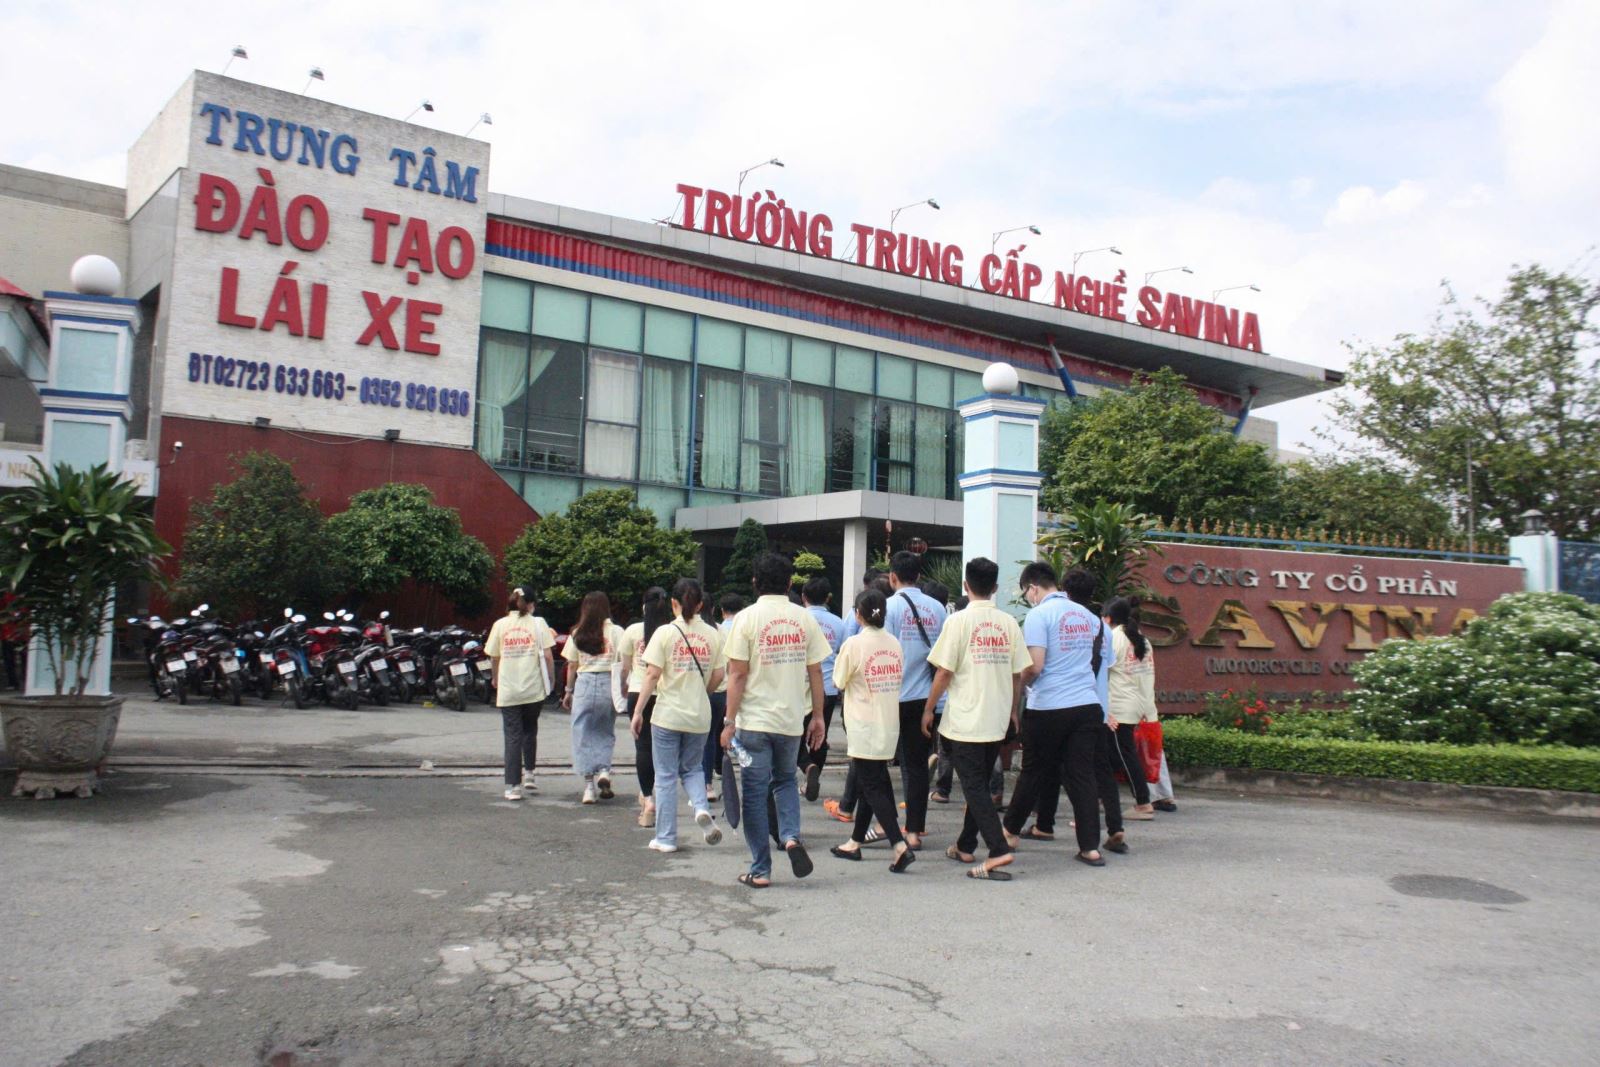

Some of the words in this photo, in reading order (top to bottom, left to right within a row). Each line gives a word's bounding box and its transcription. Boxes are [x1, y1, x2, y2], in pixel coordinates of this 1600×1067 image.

[201, 102, 360, 176] TRUNG
[389, 146, 480, 204] TÂM
[194, 167, 330, 251] ĐÀO
[363, 207, 475, 285] TẠO
[677, 183, 834, 260] TRƯỜNG
[851, 223, 964, 288] TRUNG
[980, 244, 1042, 302] CẤP
[1055, 269, 1128, 323] NGHỀ
[1136, 286, 1264, 354] SAVINA
[218, 260, 328, 340] LÁI
[355, 290, 443, 356] XE
[1163, 562, 1260, 588] CÔNG
[1270, 570, 1315, 590] TY
[1325, 564, 1368, 593] CỔ
[1376, 569, 1458, 597] PHẦN
[906, 616, 934, 626] SAINA
[1138, 594, 1480, 650] SAVIN
[504, 636, 532, 646] SAVINA
[766, 633, 801, 647] SAVINA
[870, 663, 901, 676] SAVINA
[1206, 657, 1321, 676] (MOTORCYCLE
